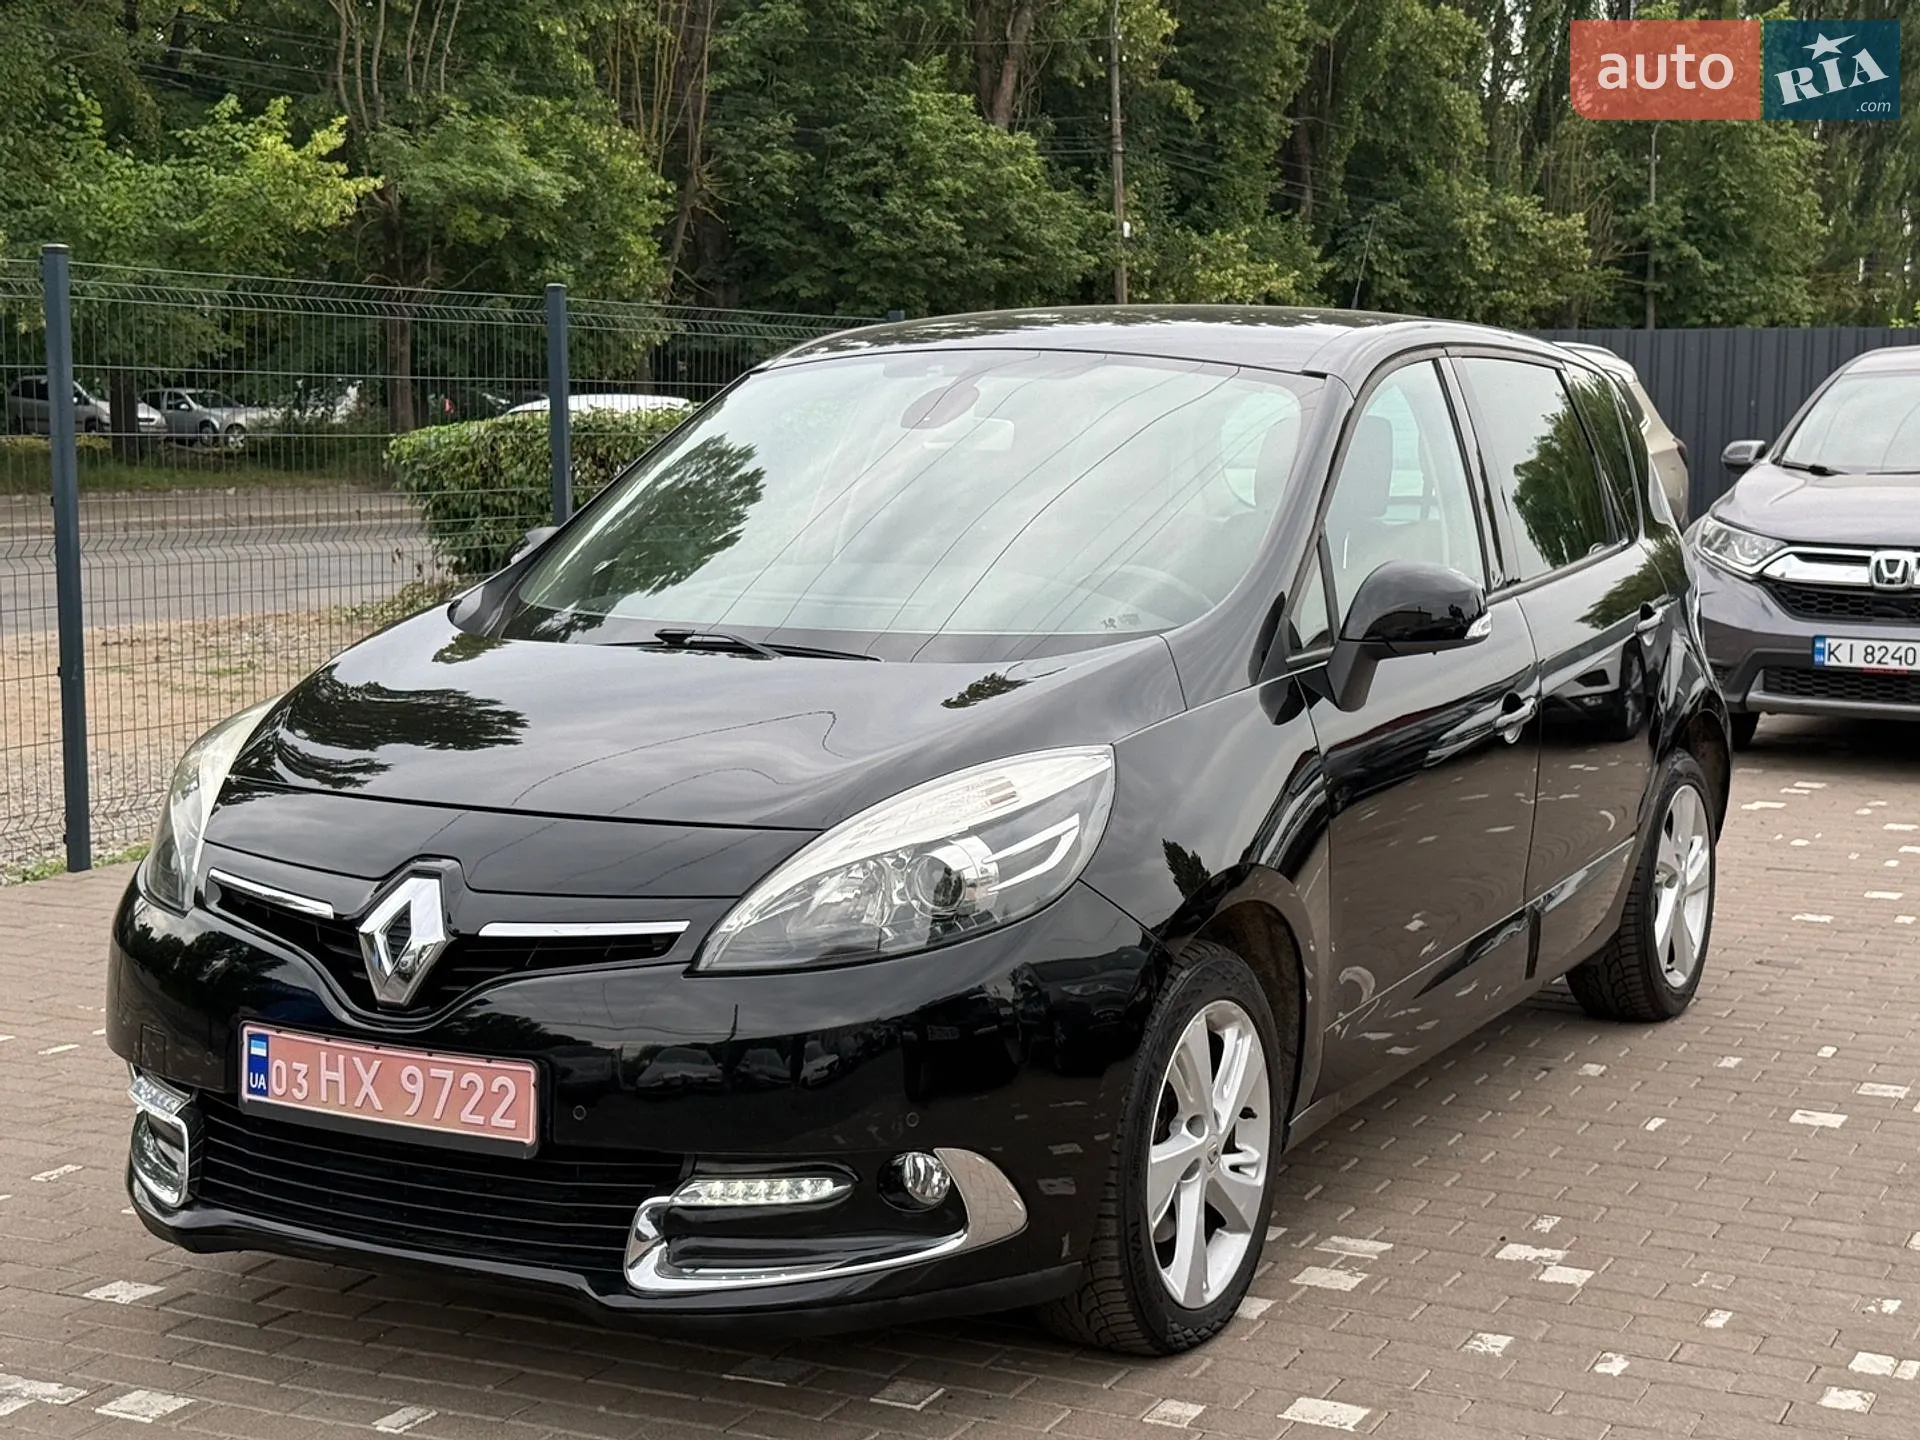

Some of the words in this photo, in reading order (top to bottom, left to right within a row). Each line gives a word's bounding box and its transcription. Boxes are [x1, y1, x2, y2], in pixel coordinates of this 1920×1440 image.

[1863, 644, 1917, 667] 8240
[250, 1071, 267, 1090] UA
[271, 1059, 309, 1100] 03
[319, 1051, 384, 1112] HX
[400, 1064, 517, 1129] 9722
